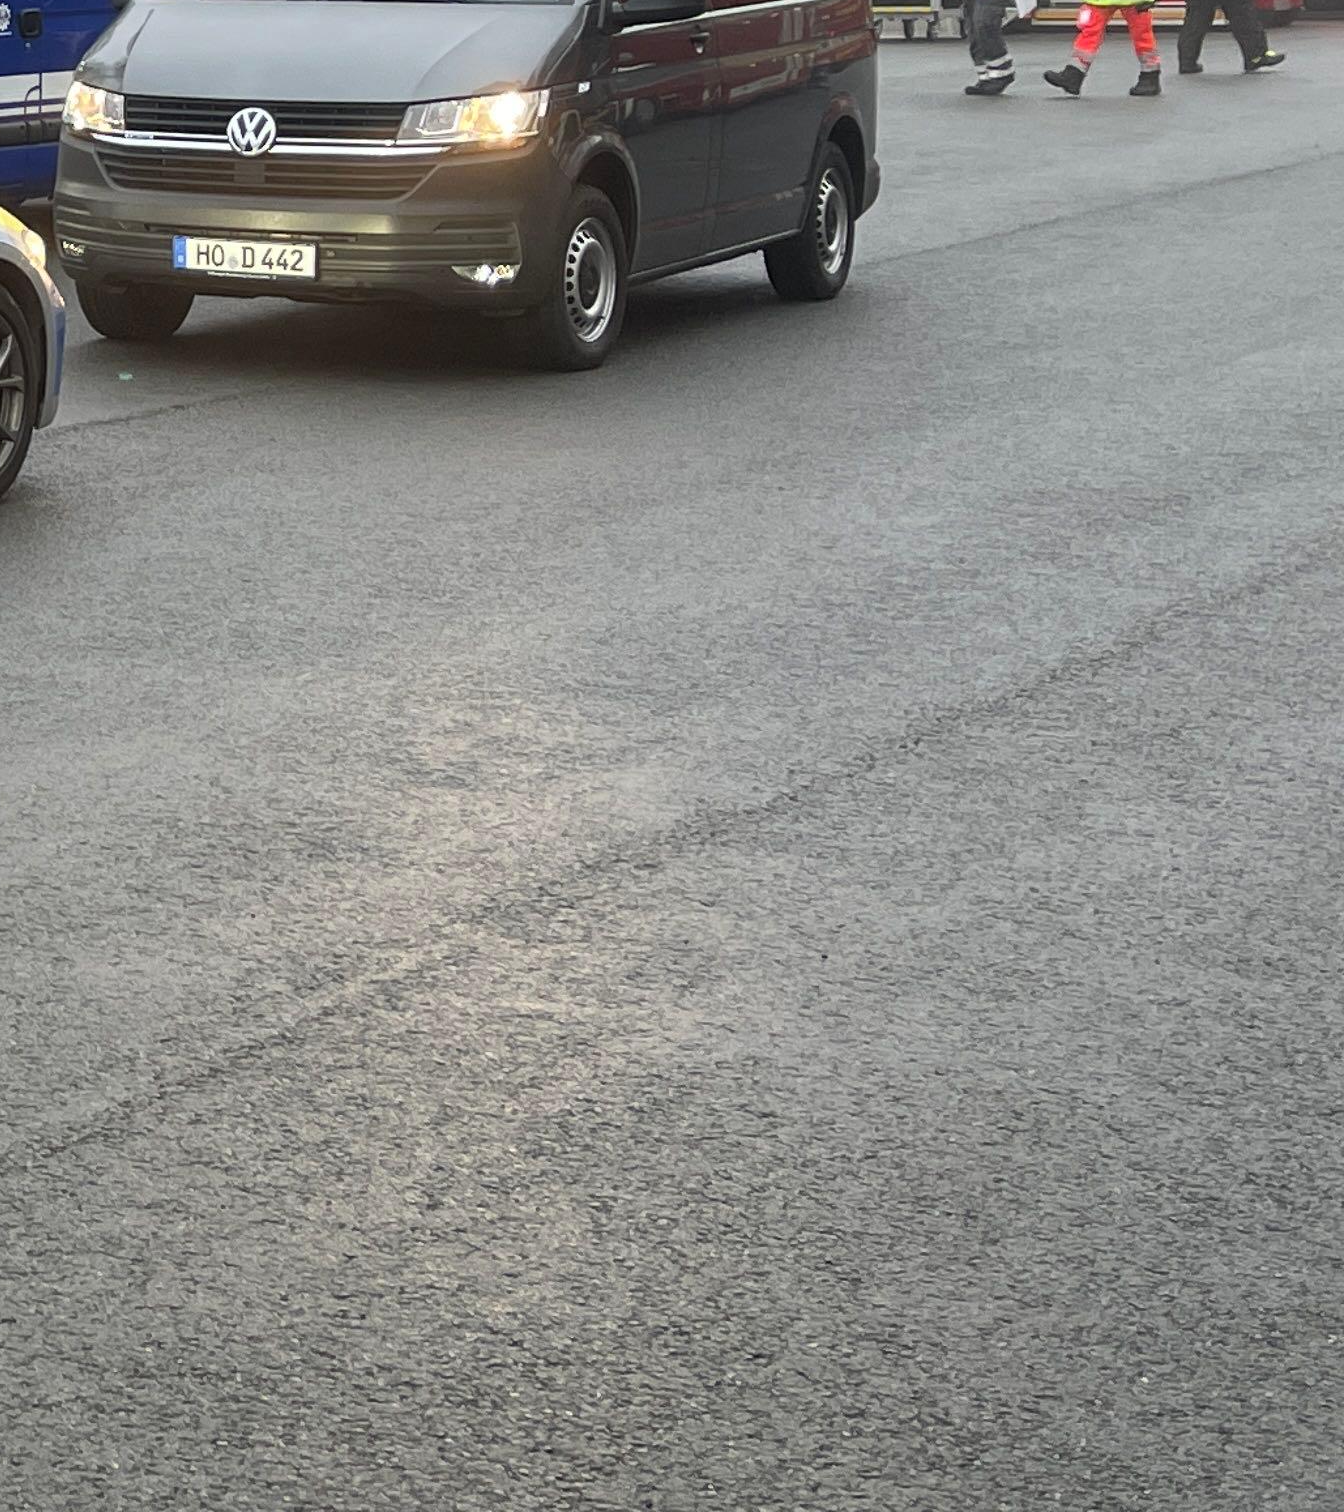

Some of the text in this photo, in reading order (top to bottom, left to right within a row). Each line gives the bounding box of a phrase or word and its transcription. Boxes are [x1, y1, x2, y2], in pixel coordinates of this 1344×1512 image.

[196, 243, 304, 272] HO D 442
